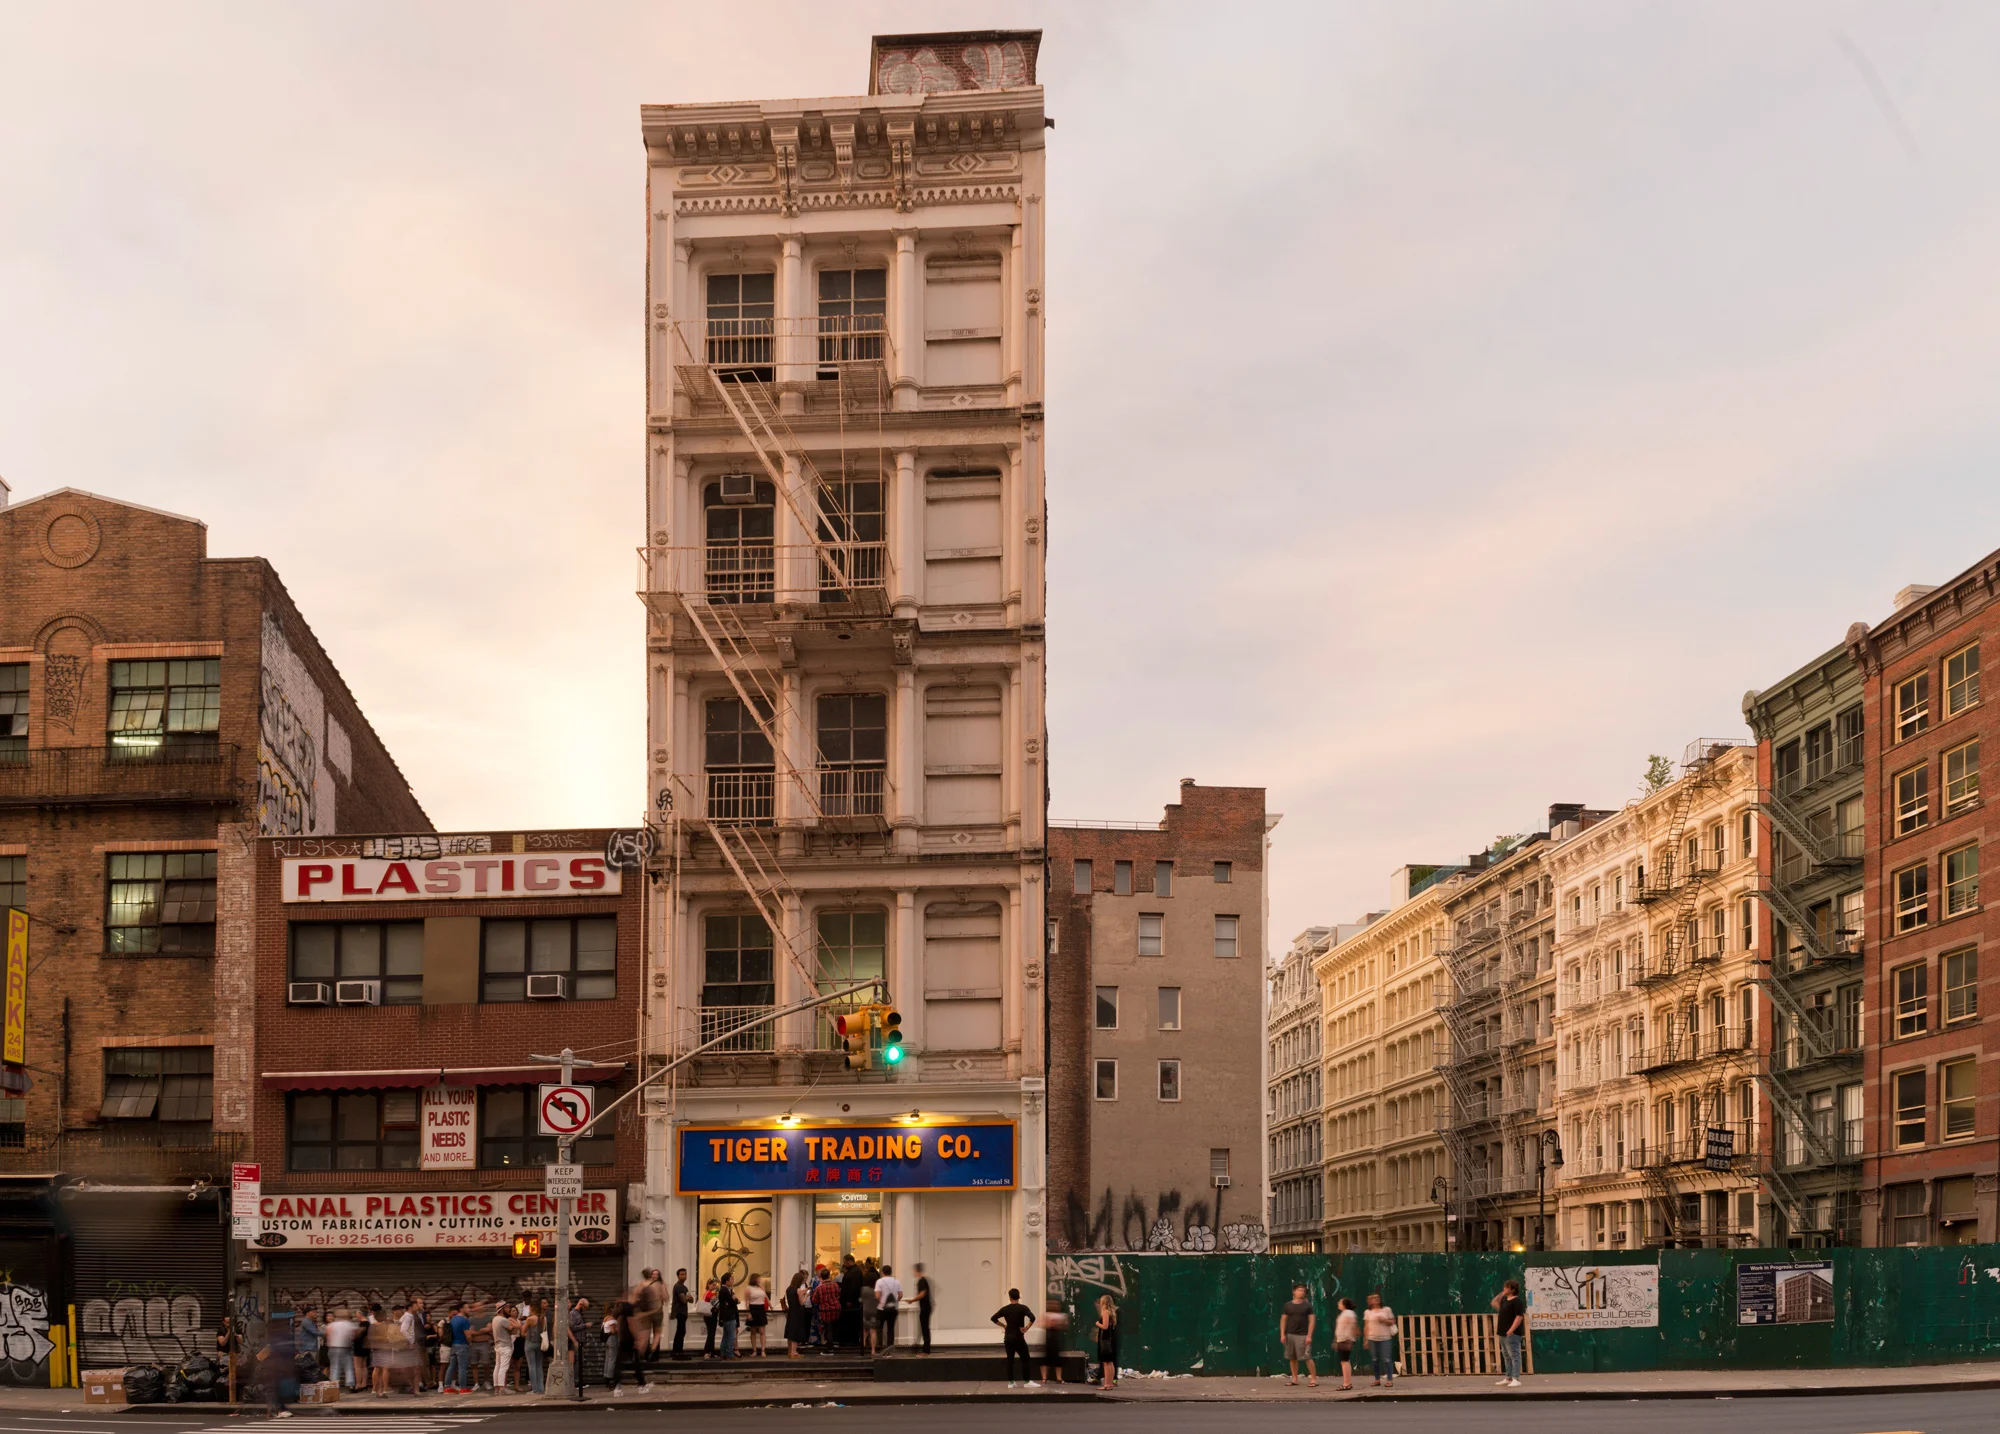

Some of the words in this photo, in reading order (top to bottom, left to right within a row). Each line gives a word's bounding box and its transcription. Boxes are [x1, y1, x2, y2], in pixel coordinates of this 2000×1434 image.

[298, 857, 606, 896] PLASTICS
[8, 912, 26, 1029] PARK
[8, 1032, 21, 1046] 24
[7, 1047, 21, 1058] HRS
[424, 1090, 444, 1105] ALL
[445, 1089, 475, 1105] YOUR
[428, 1111, 470, 1126] PLASTIC
[432, 1132, 466, 1147] NEEDS
[1708, 1131, 1733, 1143] BLUE
[710, 1137, 788, 1163] TIGER
[804, 1134, 922, 1161] TRADING
[937, 1134, 980, 1159] CO.
[424, 1153, 441, 1162] AND
[805, 1167, 883, 1182] 虎牌商行
[234, 1182, 239, 1190] 3
[260, 1198, 352, 1218] CANAL
[366, 1195, 493, 1217] PLASTICS
[508, 1193, 608, 1214] CENER
[234, 1217, 239, 1225] 5
[262, 1219, 312, 1231] USTOM
[322, 1218, 422, 1231] FABRICATION
[439, 1217, 504, 1229] CUTTING
[521, 1215, 611, 1228] ENGRVING
[260, 1234, 281, 1246] 345
[307, 1234, 335, 1245] Tel:
[339, 1233, 414, 1245] 925-1666
[435, 1233, 472, 1243] Fax:
[582, 1230, 602, 1241] 345
[1531, 1320, 1617, 1328] CONSTRUCTION
